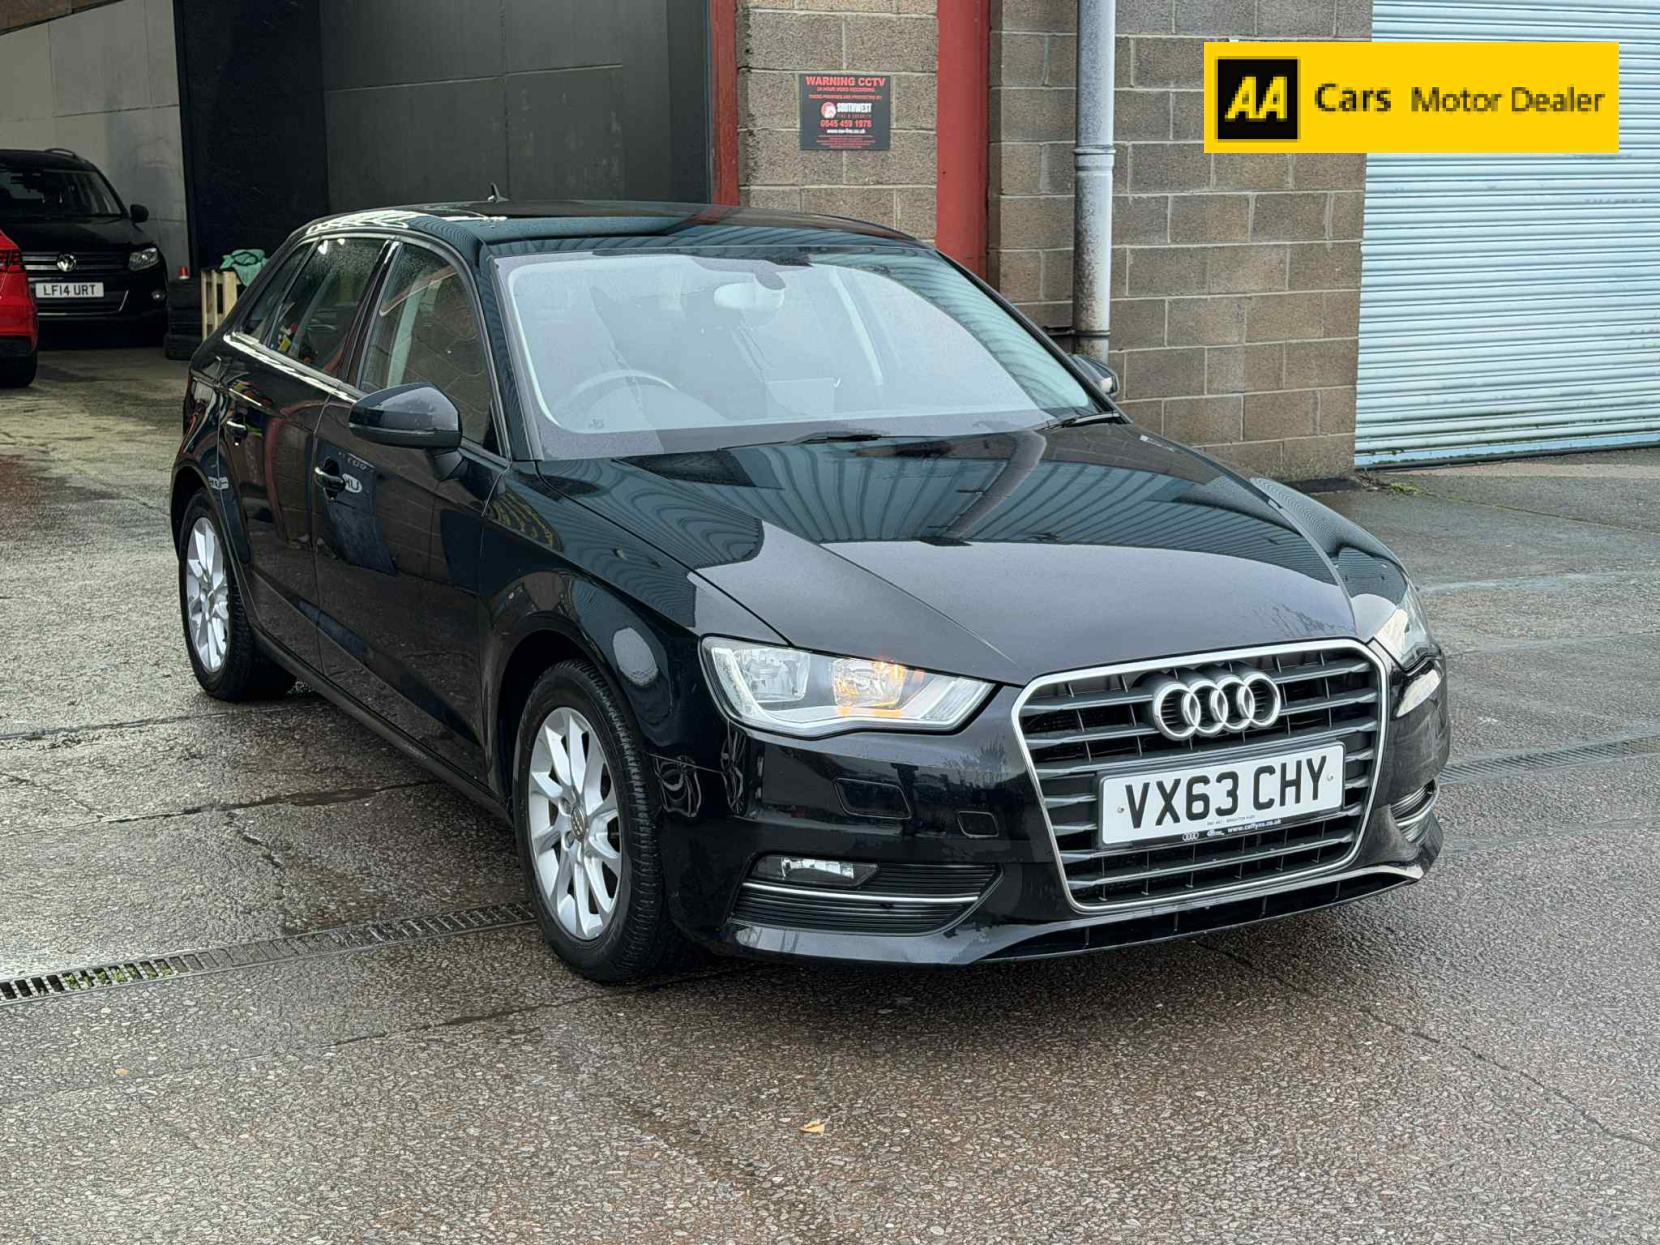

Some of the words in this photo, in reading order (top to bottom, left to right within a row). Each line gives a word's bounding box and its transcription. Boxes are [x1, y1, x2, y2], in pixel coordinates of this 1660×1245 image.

[806, 76, 855, 86] WARNING
[858, 77, 886, 87] CCTV
[837, 102, 872, 113] SOUTHWEST
[43, 284, 70, 296] LF14
[73, 284, 96, 296] URT
[1124, 771, 1239, 829] VX63
[1252, 755, 1327, 811] CHY
